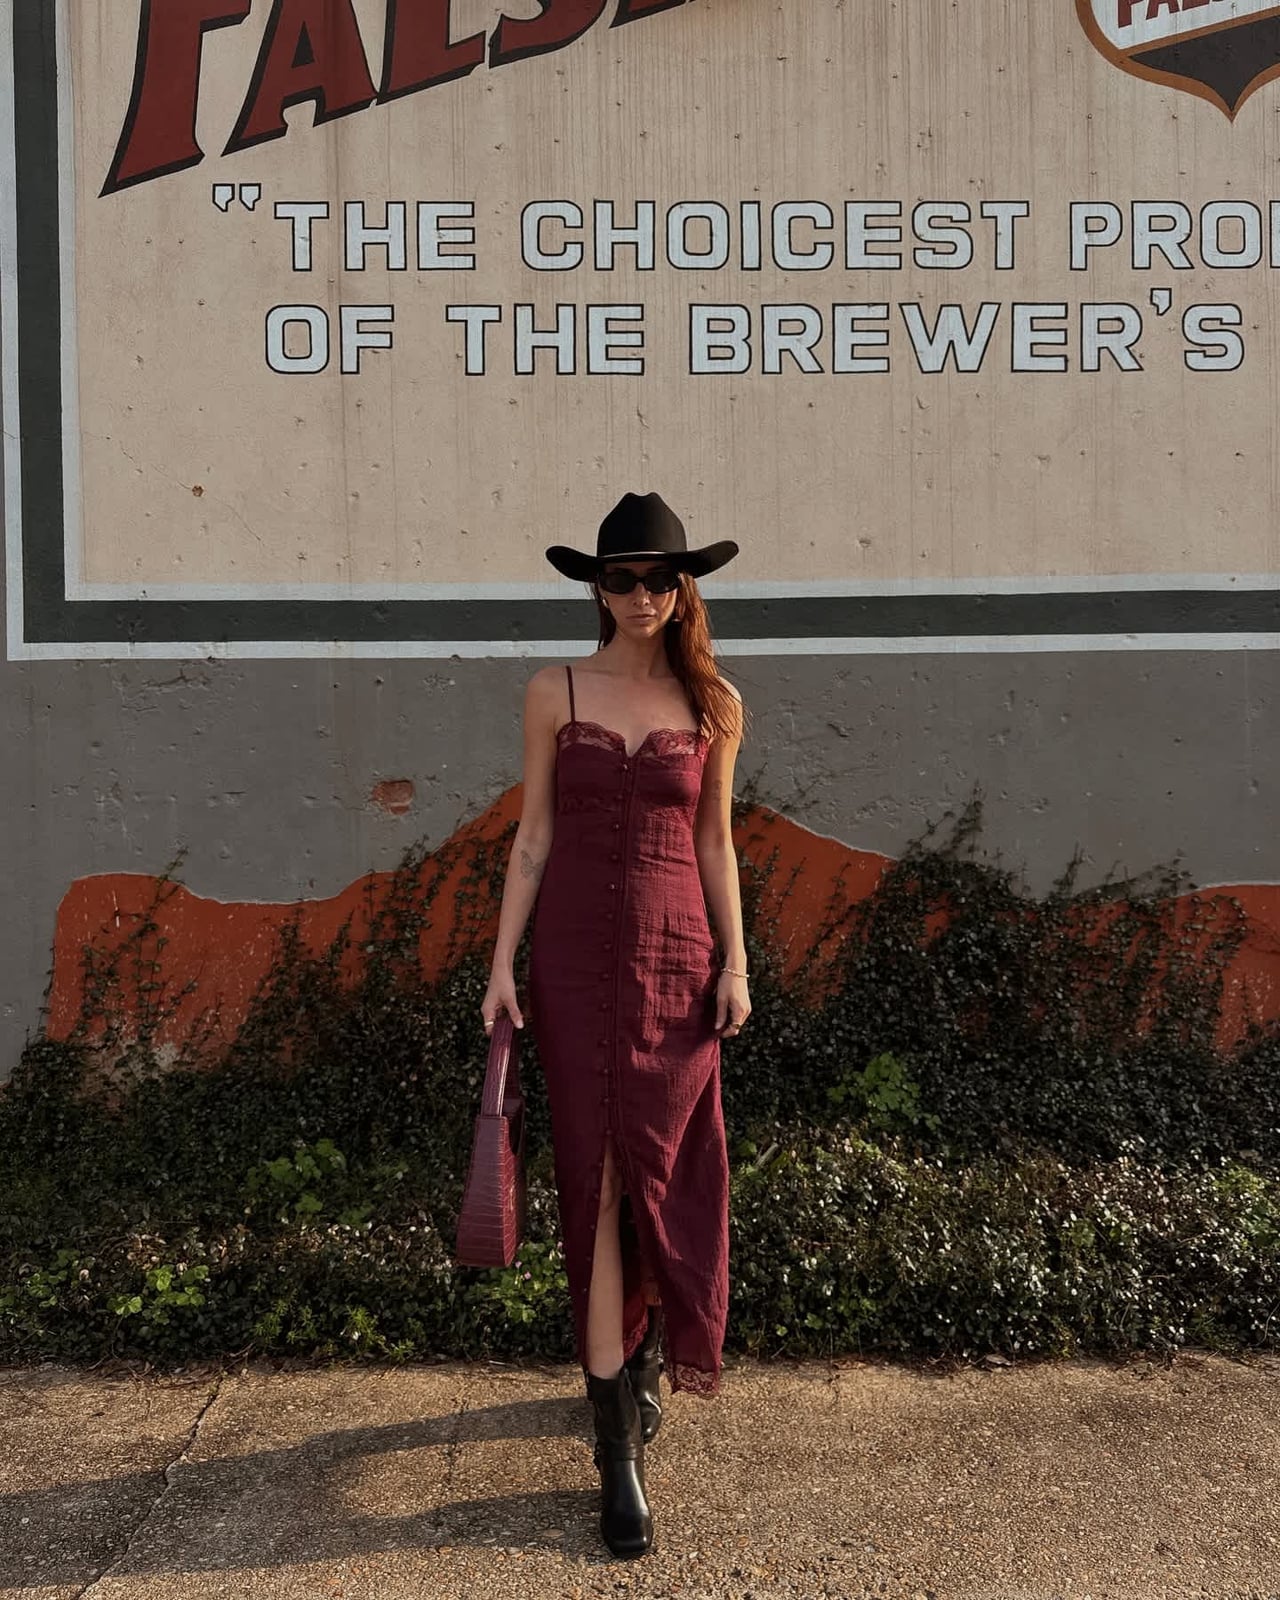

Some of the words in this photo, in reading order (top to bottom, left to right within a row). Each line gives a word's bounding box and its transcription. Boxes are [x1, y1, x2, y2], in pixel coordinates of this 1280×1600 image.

[521, 200, 1030, 271] CHOICEST
[1070, 200, 1280, 270] PRO
[265, 304, 395, 375] OF
[446, 303, 645, 376] THE
[689, 288, 1245, 375] BREWER'S
